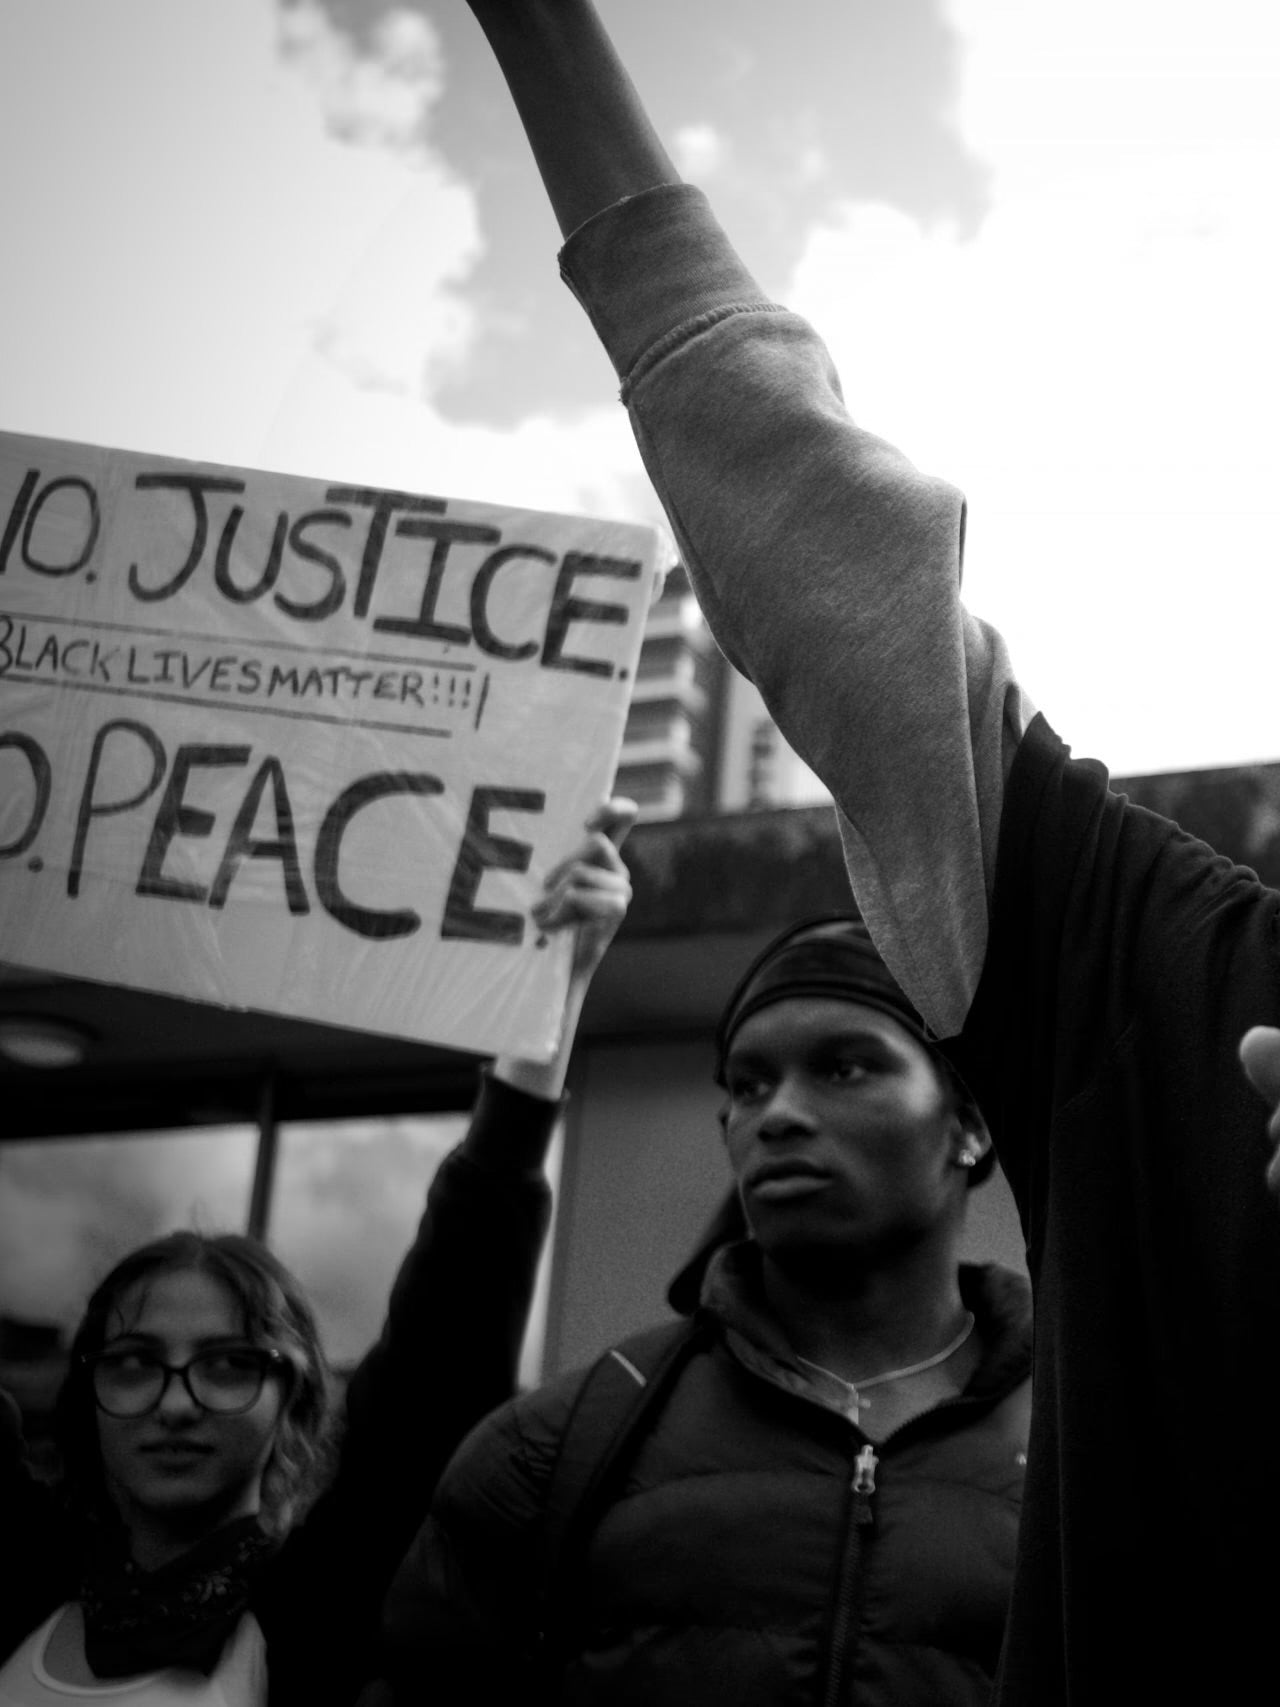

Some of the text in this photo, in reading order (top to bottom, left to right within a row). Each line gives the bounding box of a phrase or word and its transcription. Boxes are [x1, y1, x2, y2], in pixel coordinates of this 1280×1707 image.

[127, 645, 261, 695] LIVES
[128, 471, 642, 681] JUSTICE.
[66, 717, 549, 949] PEACE.
